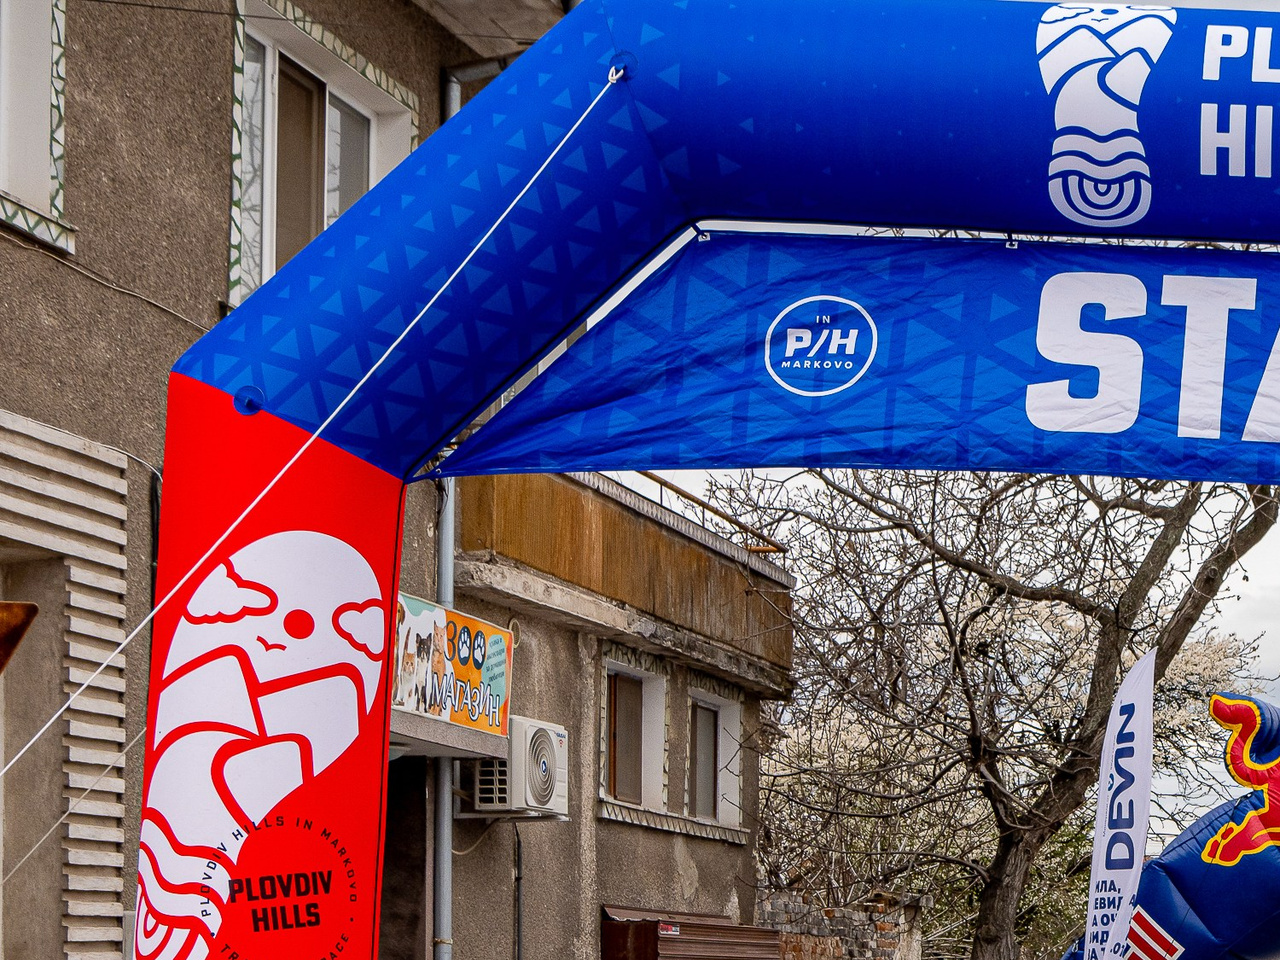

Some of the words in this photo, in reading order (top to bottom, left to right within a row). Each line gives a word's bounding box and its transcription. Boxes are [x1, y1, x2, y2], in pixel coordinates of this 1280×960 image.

[816, 315, 831, 324] IN
[785, 328, 859, 358] P/H
[781, 360, 854, 370] MARKOVO
[431, 671, 501, 728] МАГАЗИН
[1105, 702, 1136, 870] DEVIN
[200, 842, 228, 917] PLOVDIV
[232, 816, 285, 841] HILLS
[296, 817, 313, 831] IN
[321, 828, 358, 903] MARKOVO
[228, 870, 333, 904] PLOVDIV
[252, 902, 321, 933] HILLS
